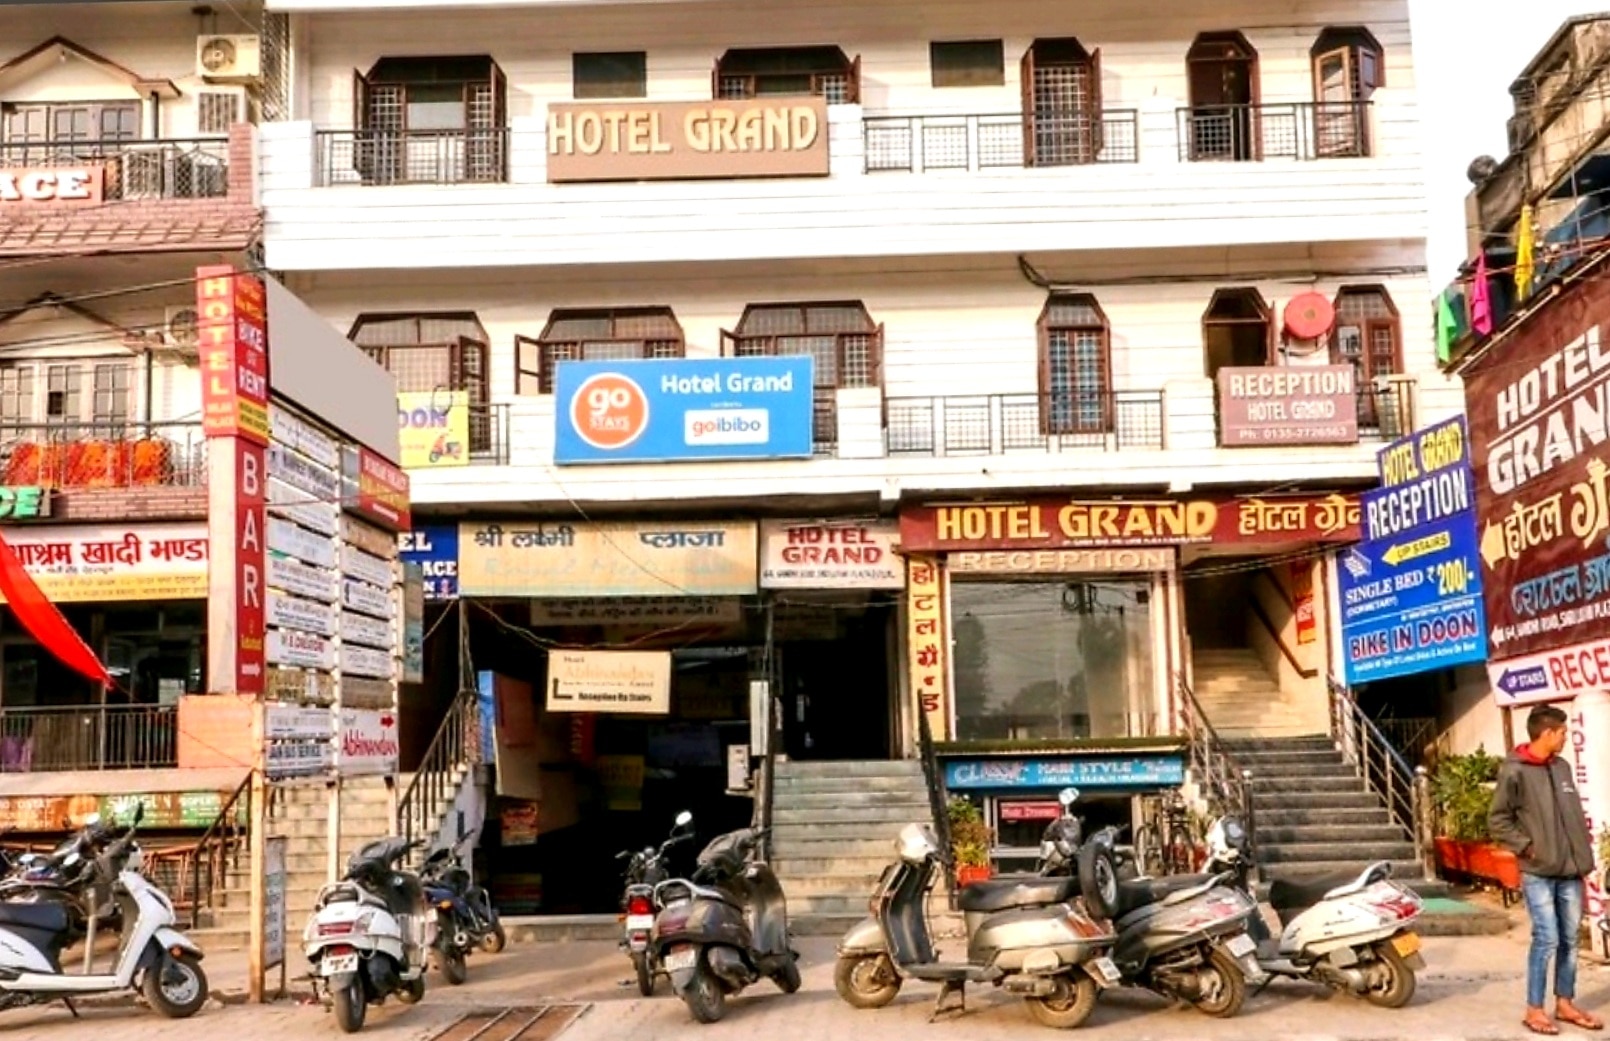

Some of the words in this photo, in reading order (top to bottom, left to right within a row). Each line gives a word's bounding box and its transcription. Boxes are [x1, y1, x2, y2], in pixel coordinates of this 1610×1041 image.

[549, 109, 673, 154] HOTEL
[684, 105, 818, 152] GRAND
[204, 277, 231, 395] HOTEL
[661, 373, 722, 395] Hotel
[727, 370, 794, 392] Grand
[1229, 371, 1351, 397] RECEPTION
[1496, 323, 1610, 431] HOTEL
[588, 387, 631, 416] go
[1247, 402, 1288, 421] HOTEL
[693, 416, 762, 438] goibibo
[1381, 441, 1419, 488] HOTEL
[1420, 420, 1463, 474] GRAND
[937, 504, 1049, 541] HOTEL
[1058, 501, 1218, 539] GRAND
[1238, 499, 1310, 535] होटल
[1367, 467, 1469, 541] RECEPTION
[242, 451, 260, 609] BAR
[474, 524, 503, 547] श्री
[640, 529, 726, 548] प्लाजा
[788, 527, 876, 545] HOTEL
[1504, 491, 1563, 560] होटल
[81, 532, 144, 566] खादी
[781, 546, 883, 564] GRAND
[959, 551, 1166, 572] RECEPTION
[1396, 543, 1411, 559] UP
[1412, 533, 1449, 555] STAIRS
[1345, 577, 1392, 607] SINGLE
[1394, 568, 1424, 594] BED
[1349, 629, 1389, 663] BIKE
[1391, 622, 1414, 653] IN
[1416, 608, 1479, 648] DOON
[1550, 643, 1610, 691] RECE
